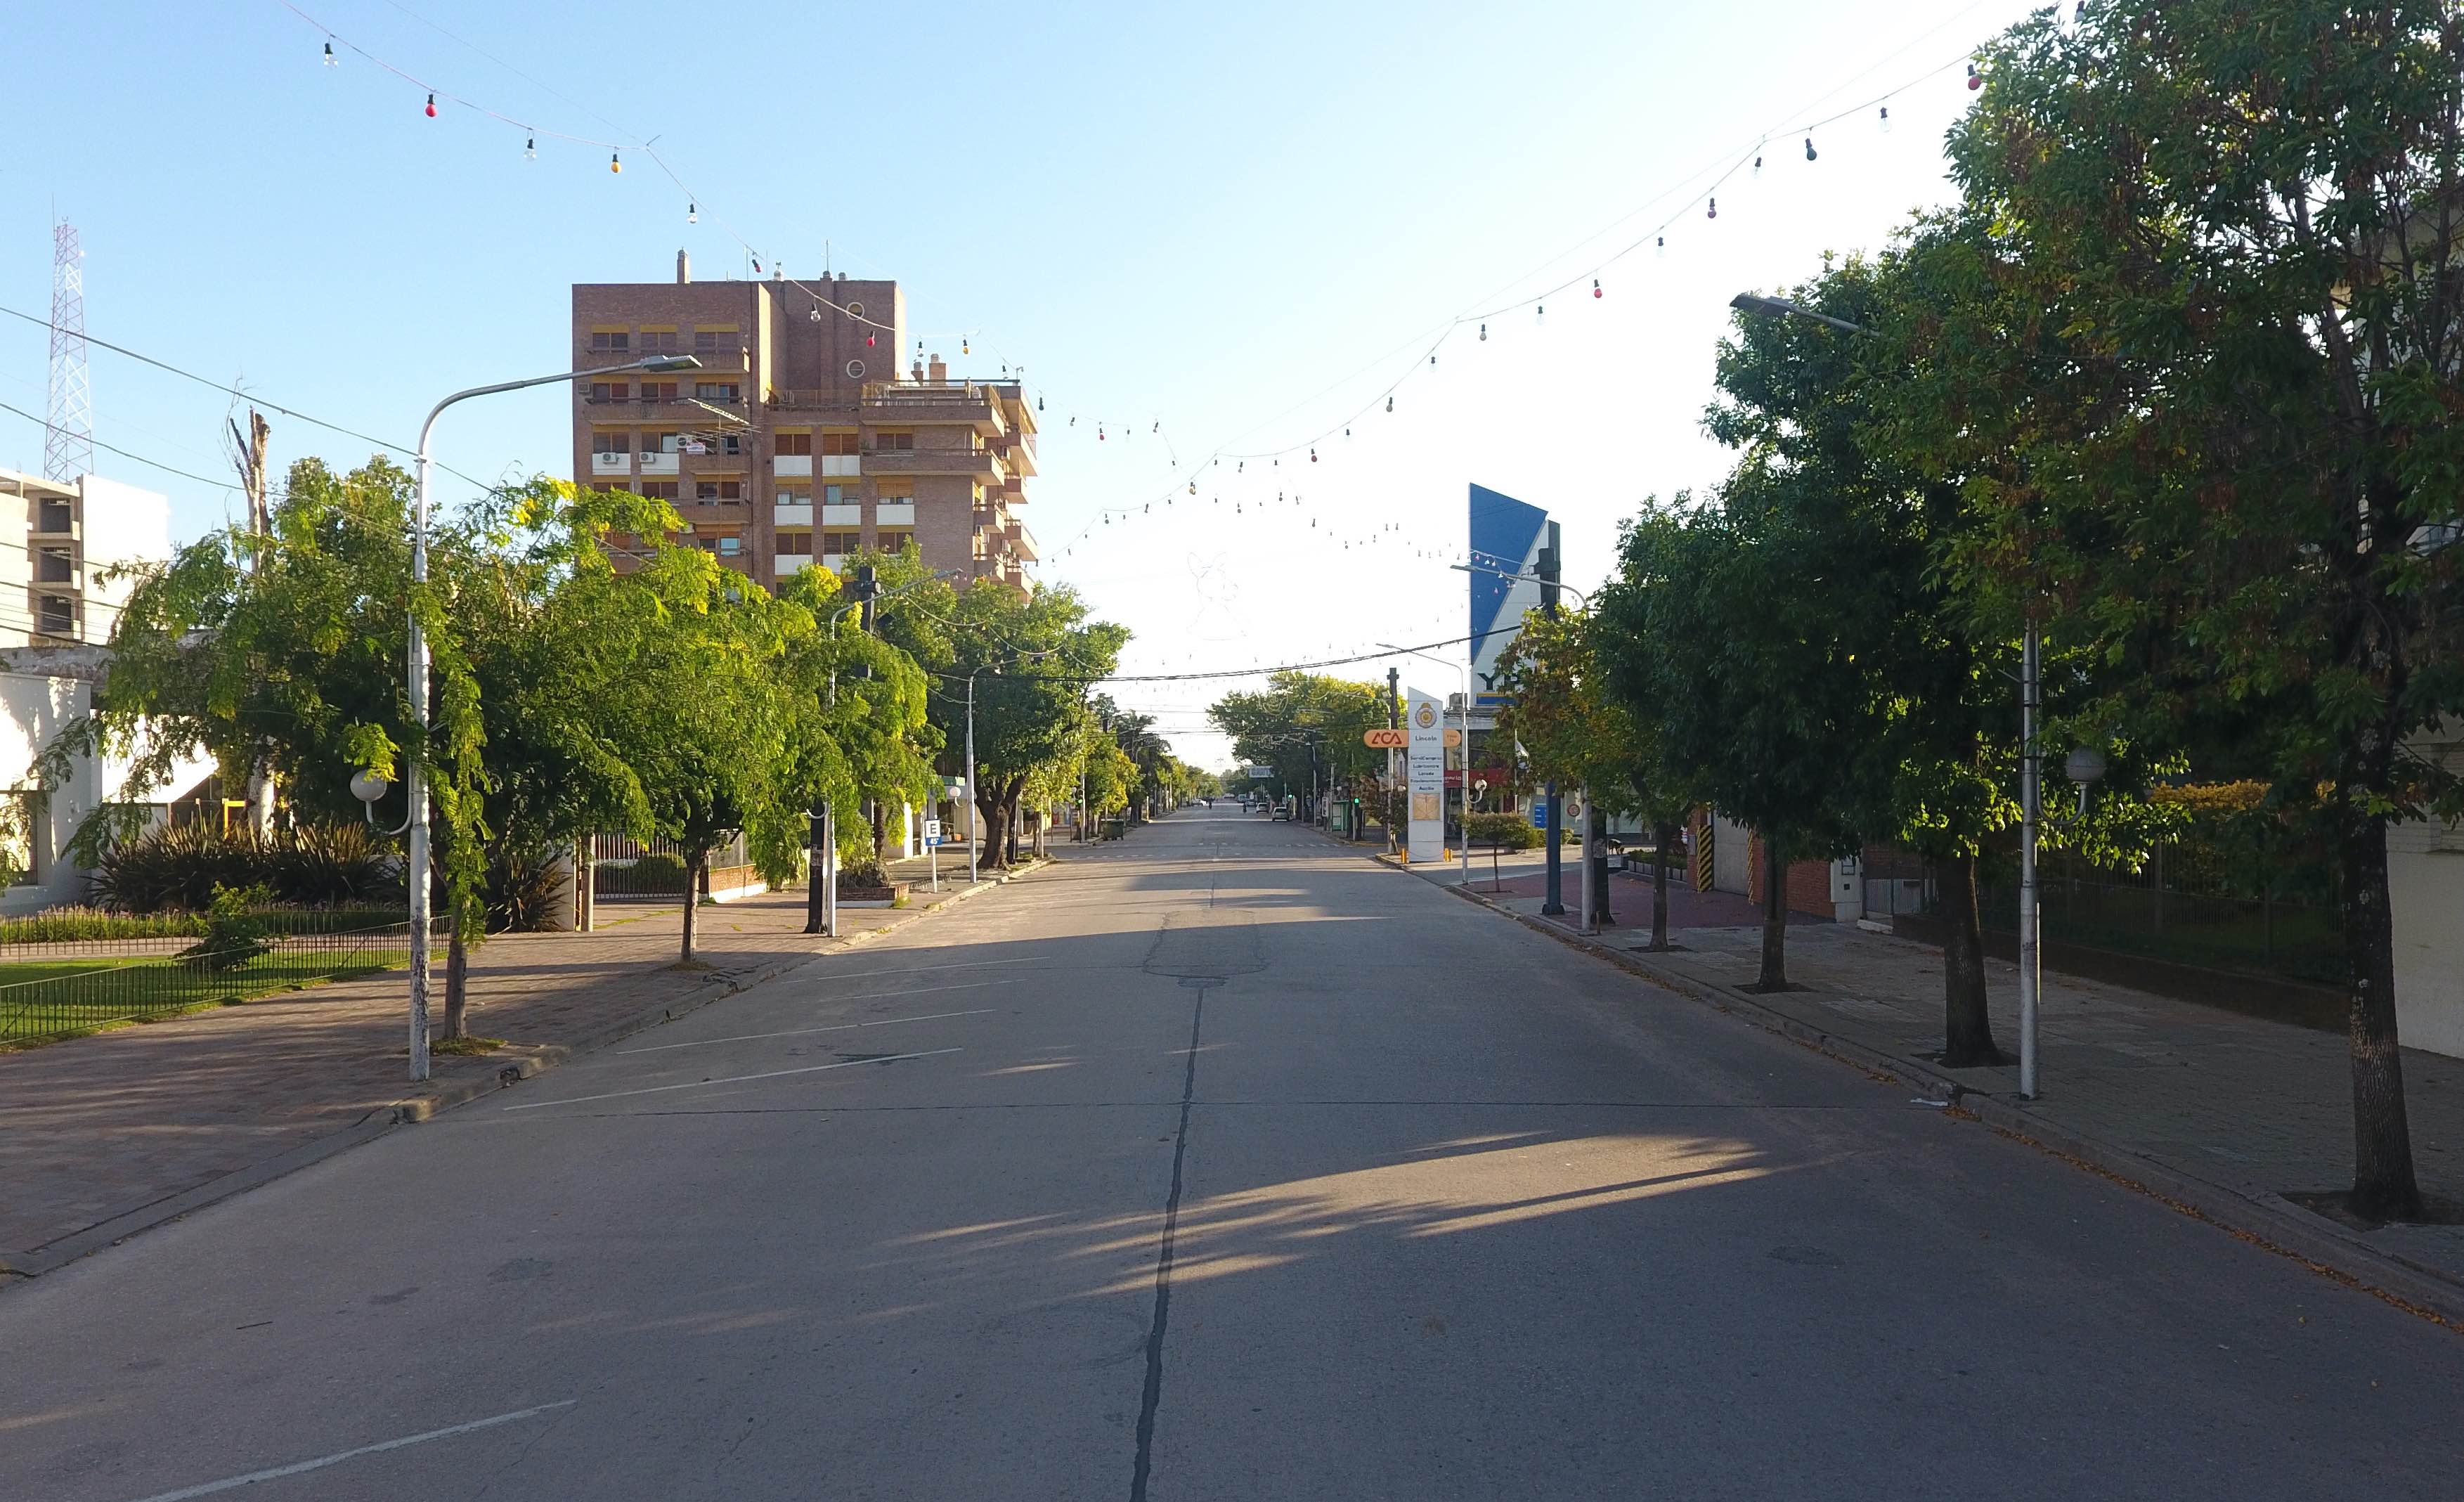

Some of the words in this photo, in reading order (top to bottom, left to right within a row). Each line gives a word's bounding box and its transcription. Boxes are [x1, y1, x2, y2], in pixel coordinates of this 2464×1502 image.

[1477, 673, 1522, 690] YP
[1372, 732, 1402, 744] ACA
[930, 823, 937, 834] E
